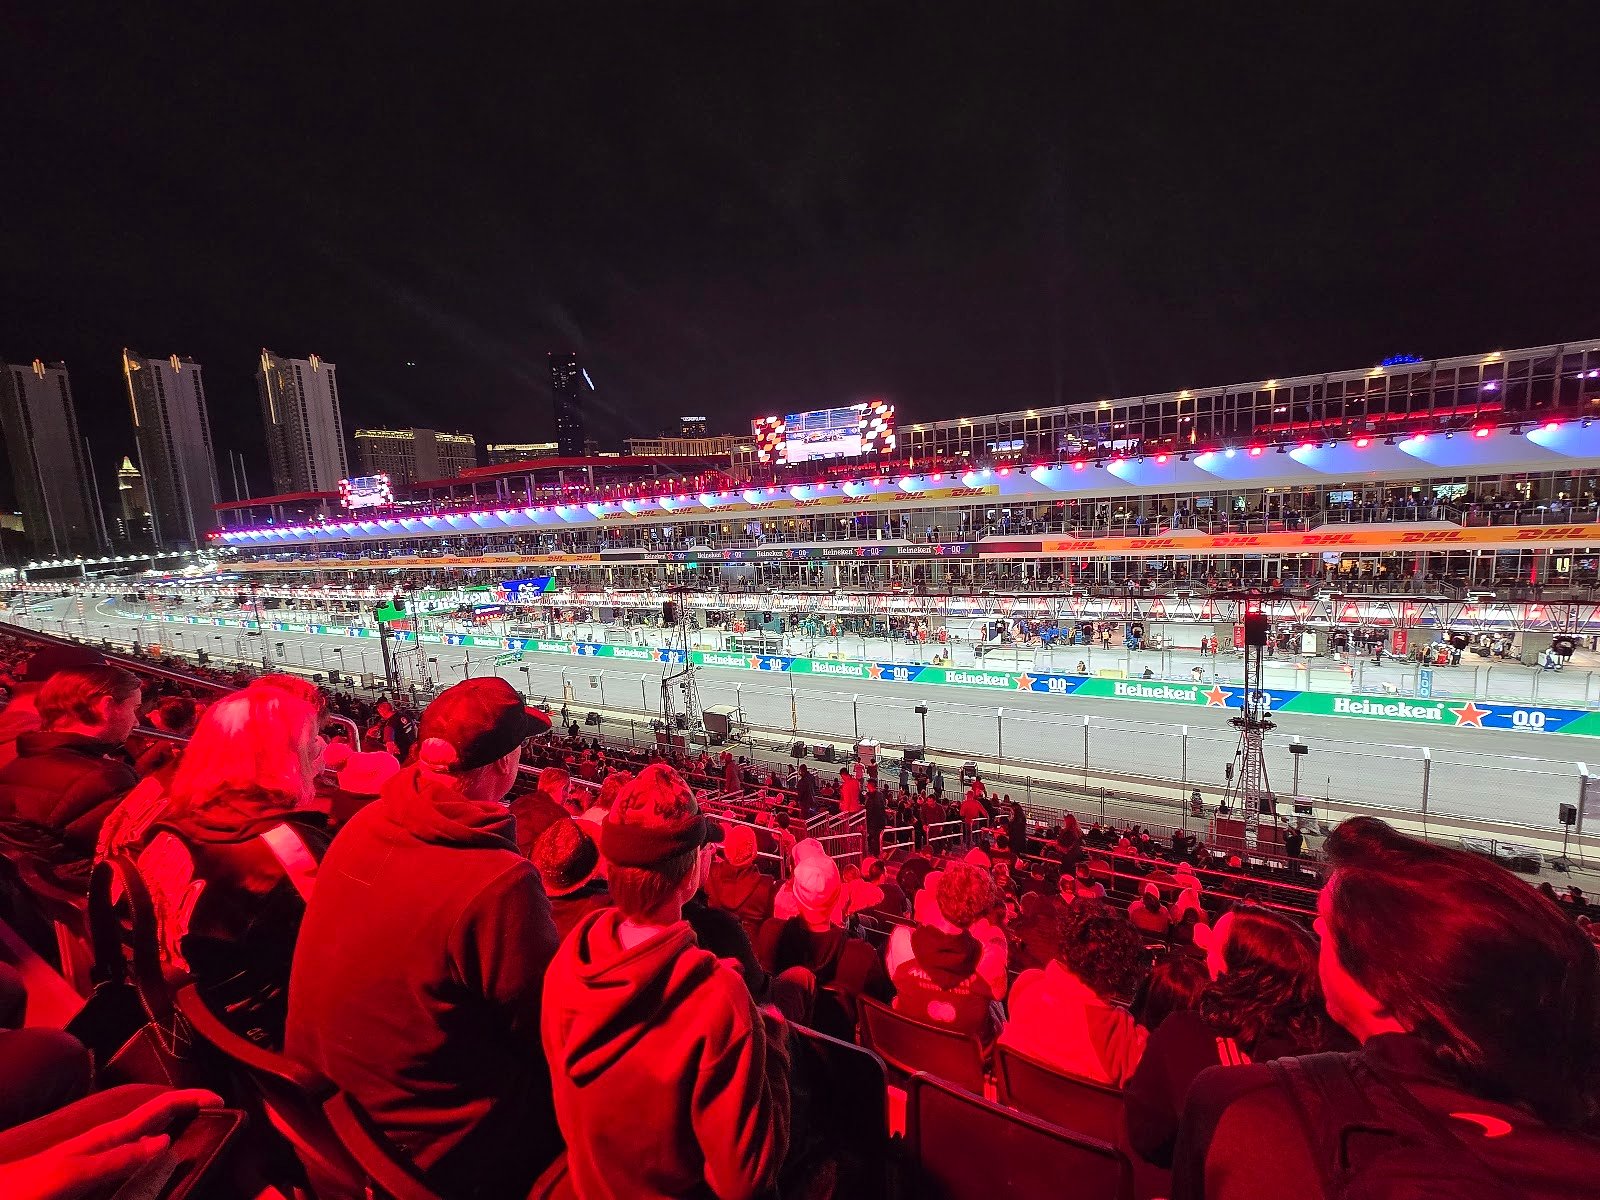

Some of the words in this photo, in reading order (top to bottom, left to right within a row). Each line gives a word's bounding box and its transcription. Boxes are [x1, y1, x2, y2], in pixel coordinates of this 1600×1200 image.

[795, 498, 822, 507] DHL
[842, 495, 872, 504] DHL
[894, 491, 927, 500] DHL
[950, 487, 987, 497] DHL
[1056, 541, 1098, 550] DHL
[1129, 538, 1176, 548] DHL
[1211, 535, 1262, 547] DHL
[1300, 533, 1357, 544] DHL
[1399, 531, 1465, 542] DHL
[1516, 527, 1589, 539] DHL
[822, 547, 854, 556] Heineken
[897, 545, 932, 554] Heineken
[613, 646, 649, 660] Heineken
[703, 652, 746, 667] Heineken
[811, 660, 864, 676] Heineken
[945, 670, 1010, 687] Heineken
[1420, 671, 1430, 697] 100
[1114, 681, 1198, 701] Heineken
[1333, 697, 1444, 721] Heineken
